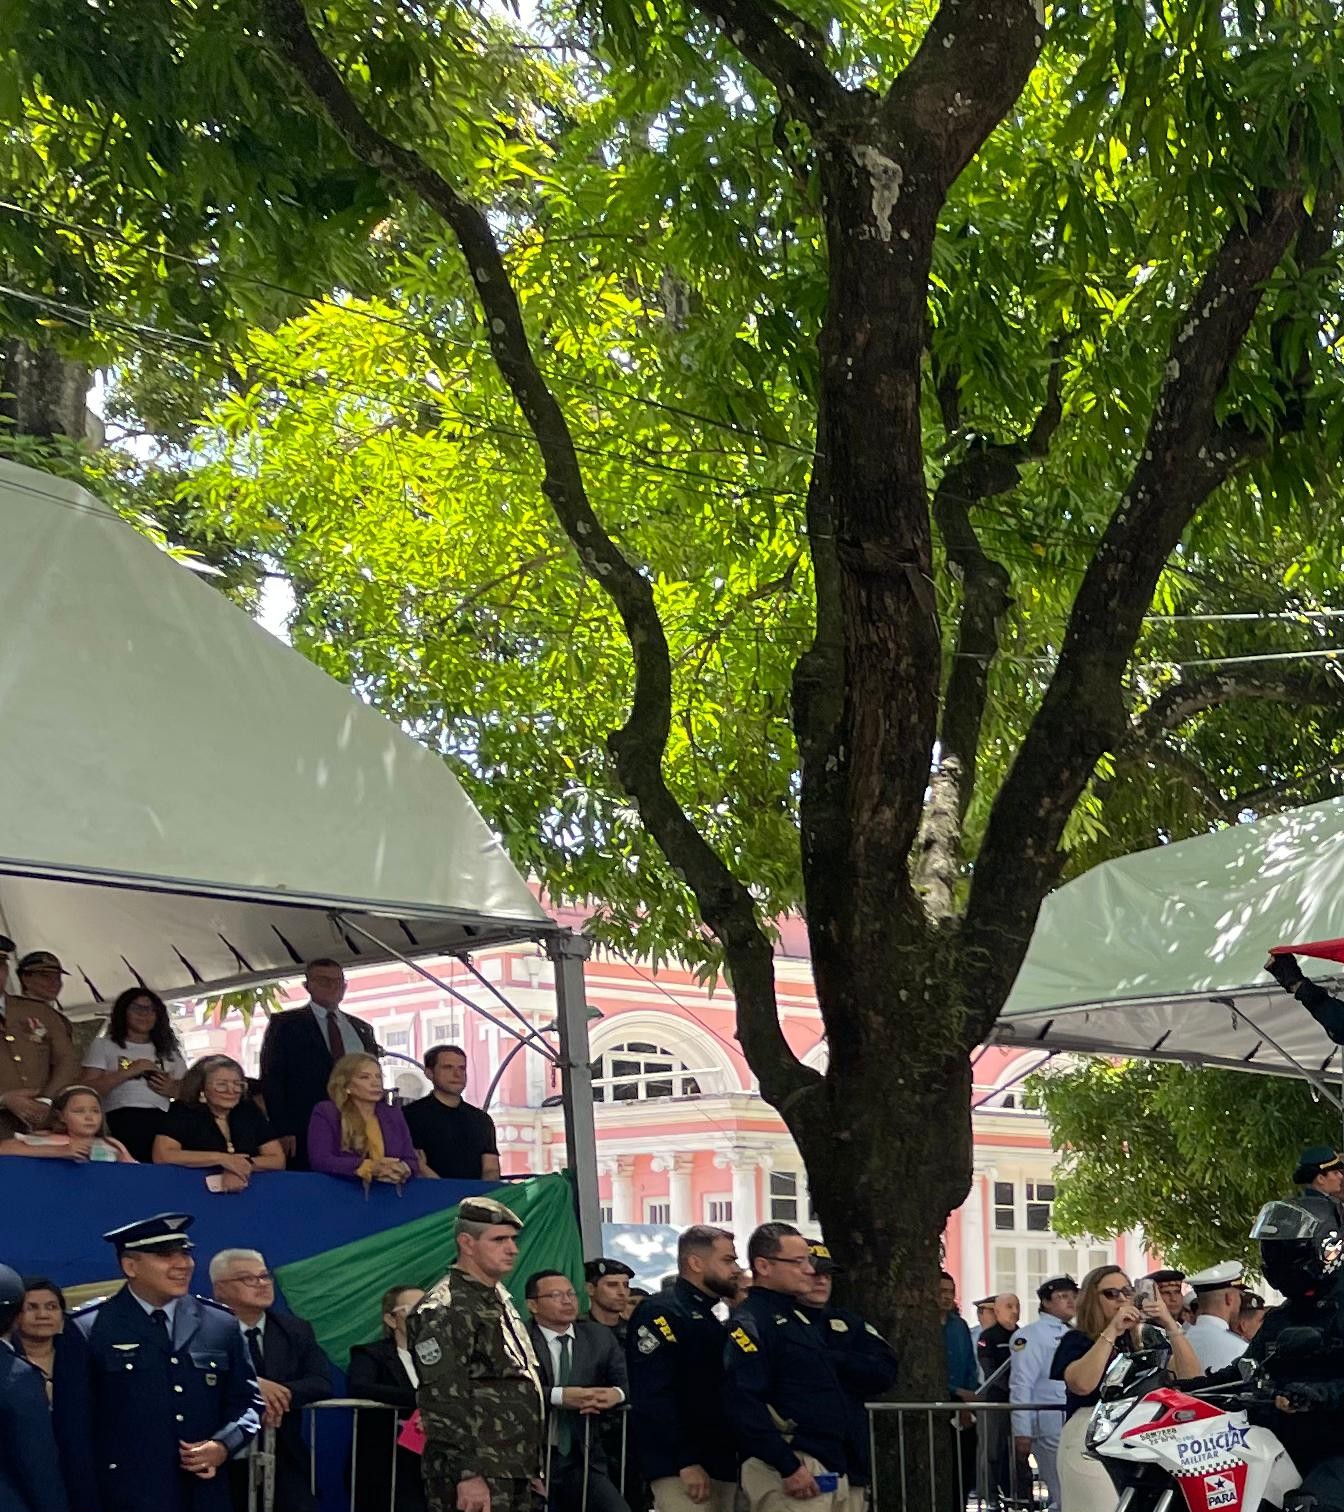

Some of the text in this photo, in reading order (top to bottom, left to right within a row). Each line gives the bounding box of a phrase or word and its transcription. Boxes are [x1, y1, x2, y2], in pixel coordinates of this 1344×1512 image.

[653, 1315, 678, 1343] PRF
[730, 1326, 758, 1353] PRF
[1180, 1450, 1220, 1466] MILITAR
